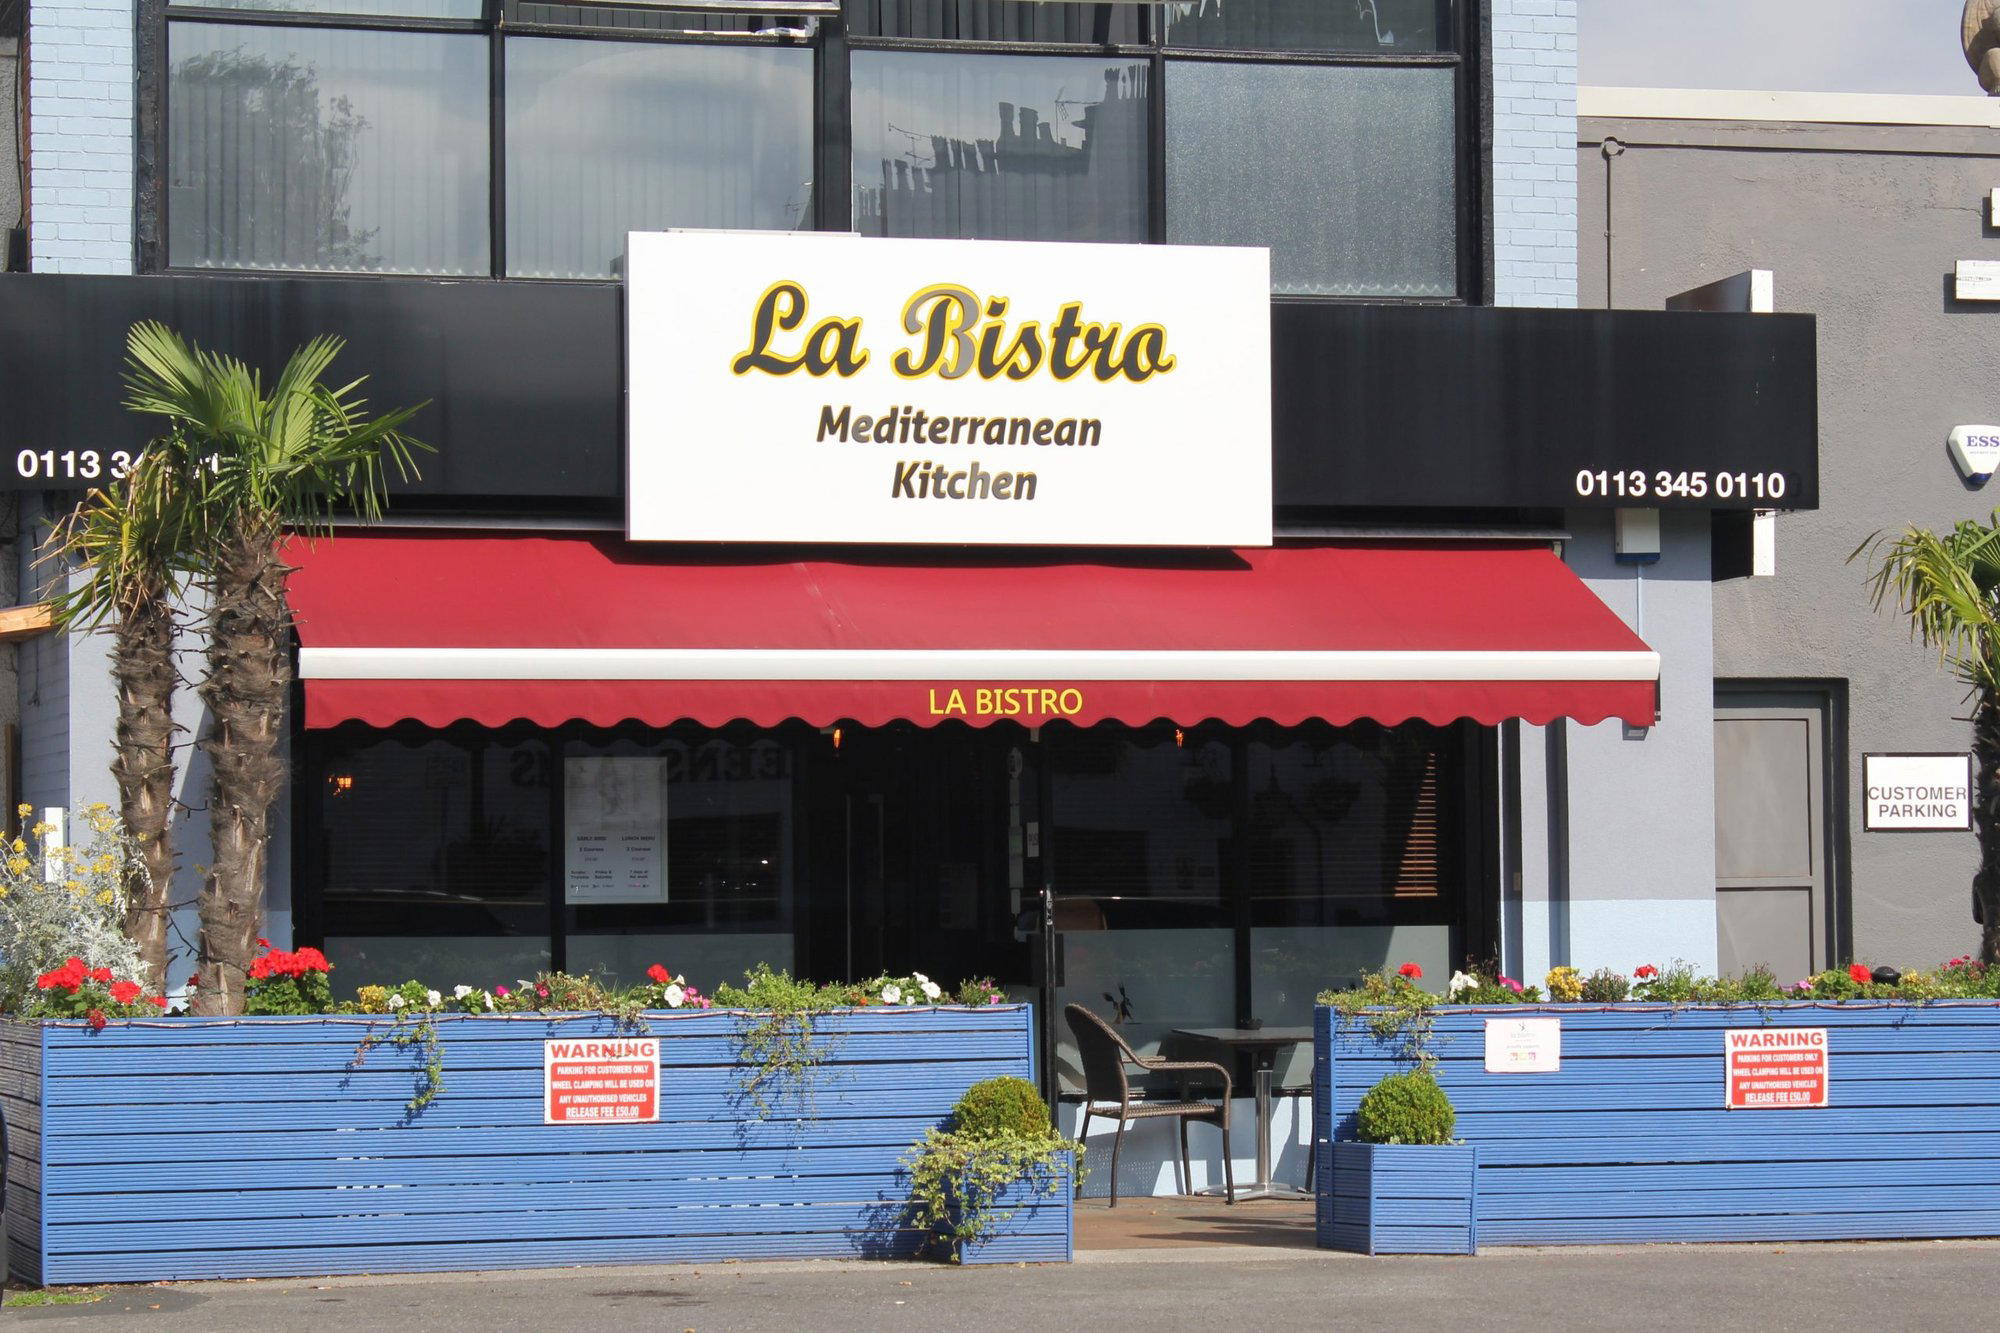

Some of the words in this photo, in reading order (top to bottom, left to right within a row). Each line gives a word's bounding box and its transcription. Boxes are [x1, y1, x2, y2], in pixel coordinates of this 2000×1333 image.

[730, 279, 871, 379] La
[890, 282, 1177, 385] Bistro
[816, 405, 1102, 447] Mediterranean
[1966, 435, 2000, 447] ESS
[17, 449, 101, 479] 0113
[891, 460, 1038, 501] Kitchen
[1576, 469, 1647, 497] 0113
[1654, 470, 1708, 498] 345
[1715, 471, 1785, 498] 0110
[929, 688, 967, 715] LA
[976, 688, 1083, 715] BISTRO
[1868, 786, 1967, 800] CUSTOMER
[1879, 804, 1957, 817] PARKING
[1730, 1032, 1823, 1047] WARNING
[551, 1043, 654, 1058] WARNING
[1737, 1054, 1761, 1063] PARKING
[1761, 1054, 1772, 1062] FOR
[1773, 1054, 1803, 1062] CUSTOMERS
[1804, 1053, 1818, 1061] ONLY
[557, 1066, 583, 1075] PARKING
[584, 1066, 596, 1074] FOR
[597, 1066, 632, 1074] CUSTOMERS
[633, 1065, 649, 1073] ONLY
[1733, 1068, 1751, 1076] WHEEL
[1752, 1068, 1778, 1076] CLAMPING
[1779, 1067, 1792, 1075] WILL
[1792, 1067, 1800, 1075] BE
[1801, 1067, 1814, 1075] USED
[1815, 1066, 1823, 1074] ON
[552, 1080, 572, 1089] WHEEL
[573, 1080, 603, 1089] CLAMPING
[604, 1080, 619, 1088] WILL
[620, 1080, 628, 1088] BE
[629, 1079, 644, 1087] USED
[645, 1079, 654, 1087] ON
[1739, 1081, 1750, 1090] ANY
[1751, 1081, 1791, 1089] UNAUTHORISED
[1792, 1080, 1817, 1088] VEHICLES
[559, 1095, 571, 1103] ANY
[573, 1094, 618, 1103] UNAUTHORISED
[619, 1094, 647, 1102] VEHICLES
[1745, 1093, 1774, 1103] RELEASE
[1775, 1092, 1788, 1102] FEE
[566, 1107, 599, 1117] RELEASE
[600, 1107, 614, 1117] FEE
[616, 1106, 639, 1116] £50.00
